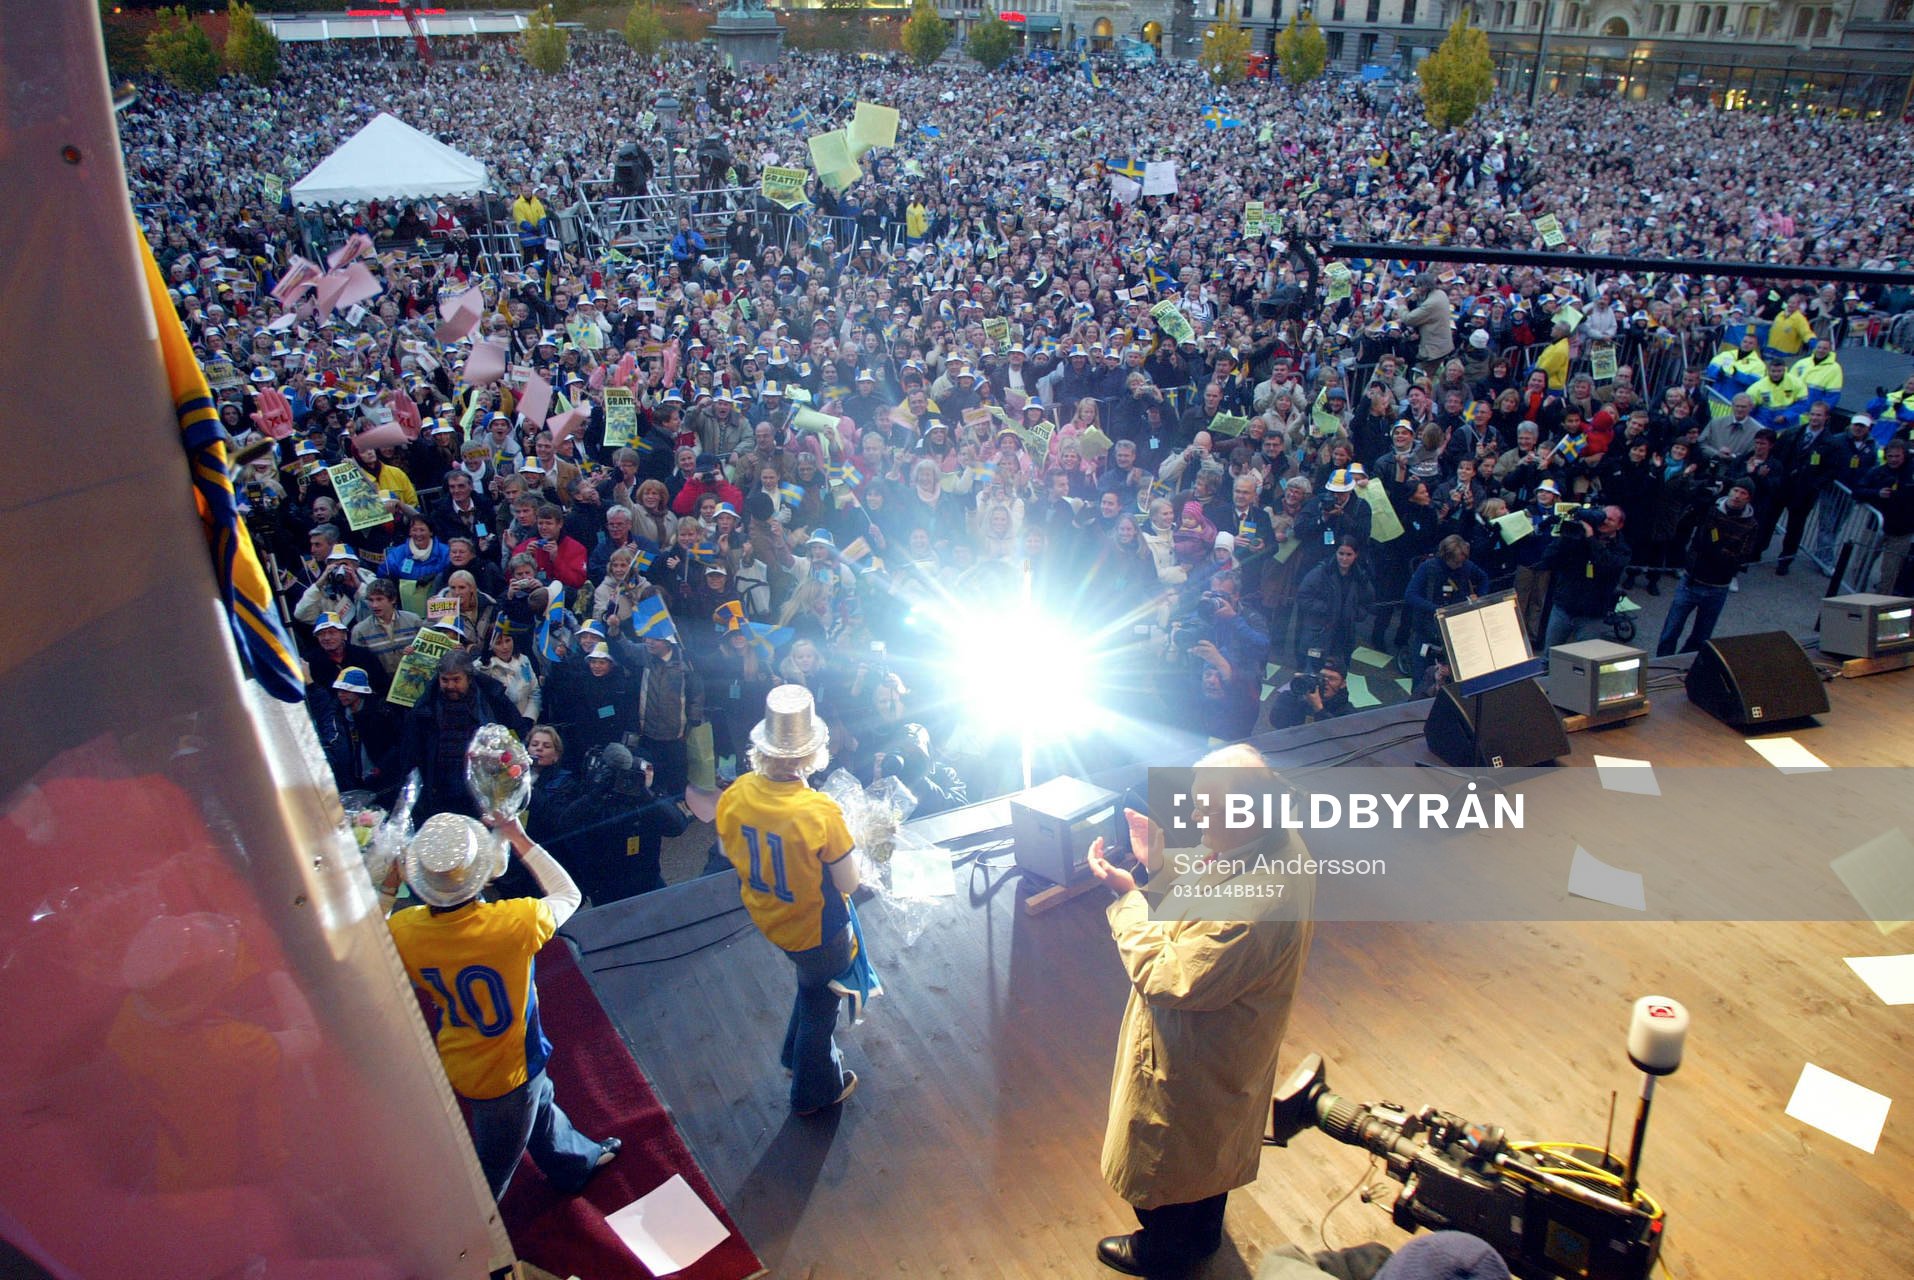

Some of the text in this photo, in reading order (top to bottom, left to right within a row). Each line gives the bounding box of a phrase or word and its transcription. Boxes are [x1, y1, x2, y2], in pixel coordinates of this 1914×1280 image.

[765, 174, 804, 185] GRATTIS
[741, 824, 795, 903] 11
[419, 964, 513, 1038] 10
